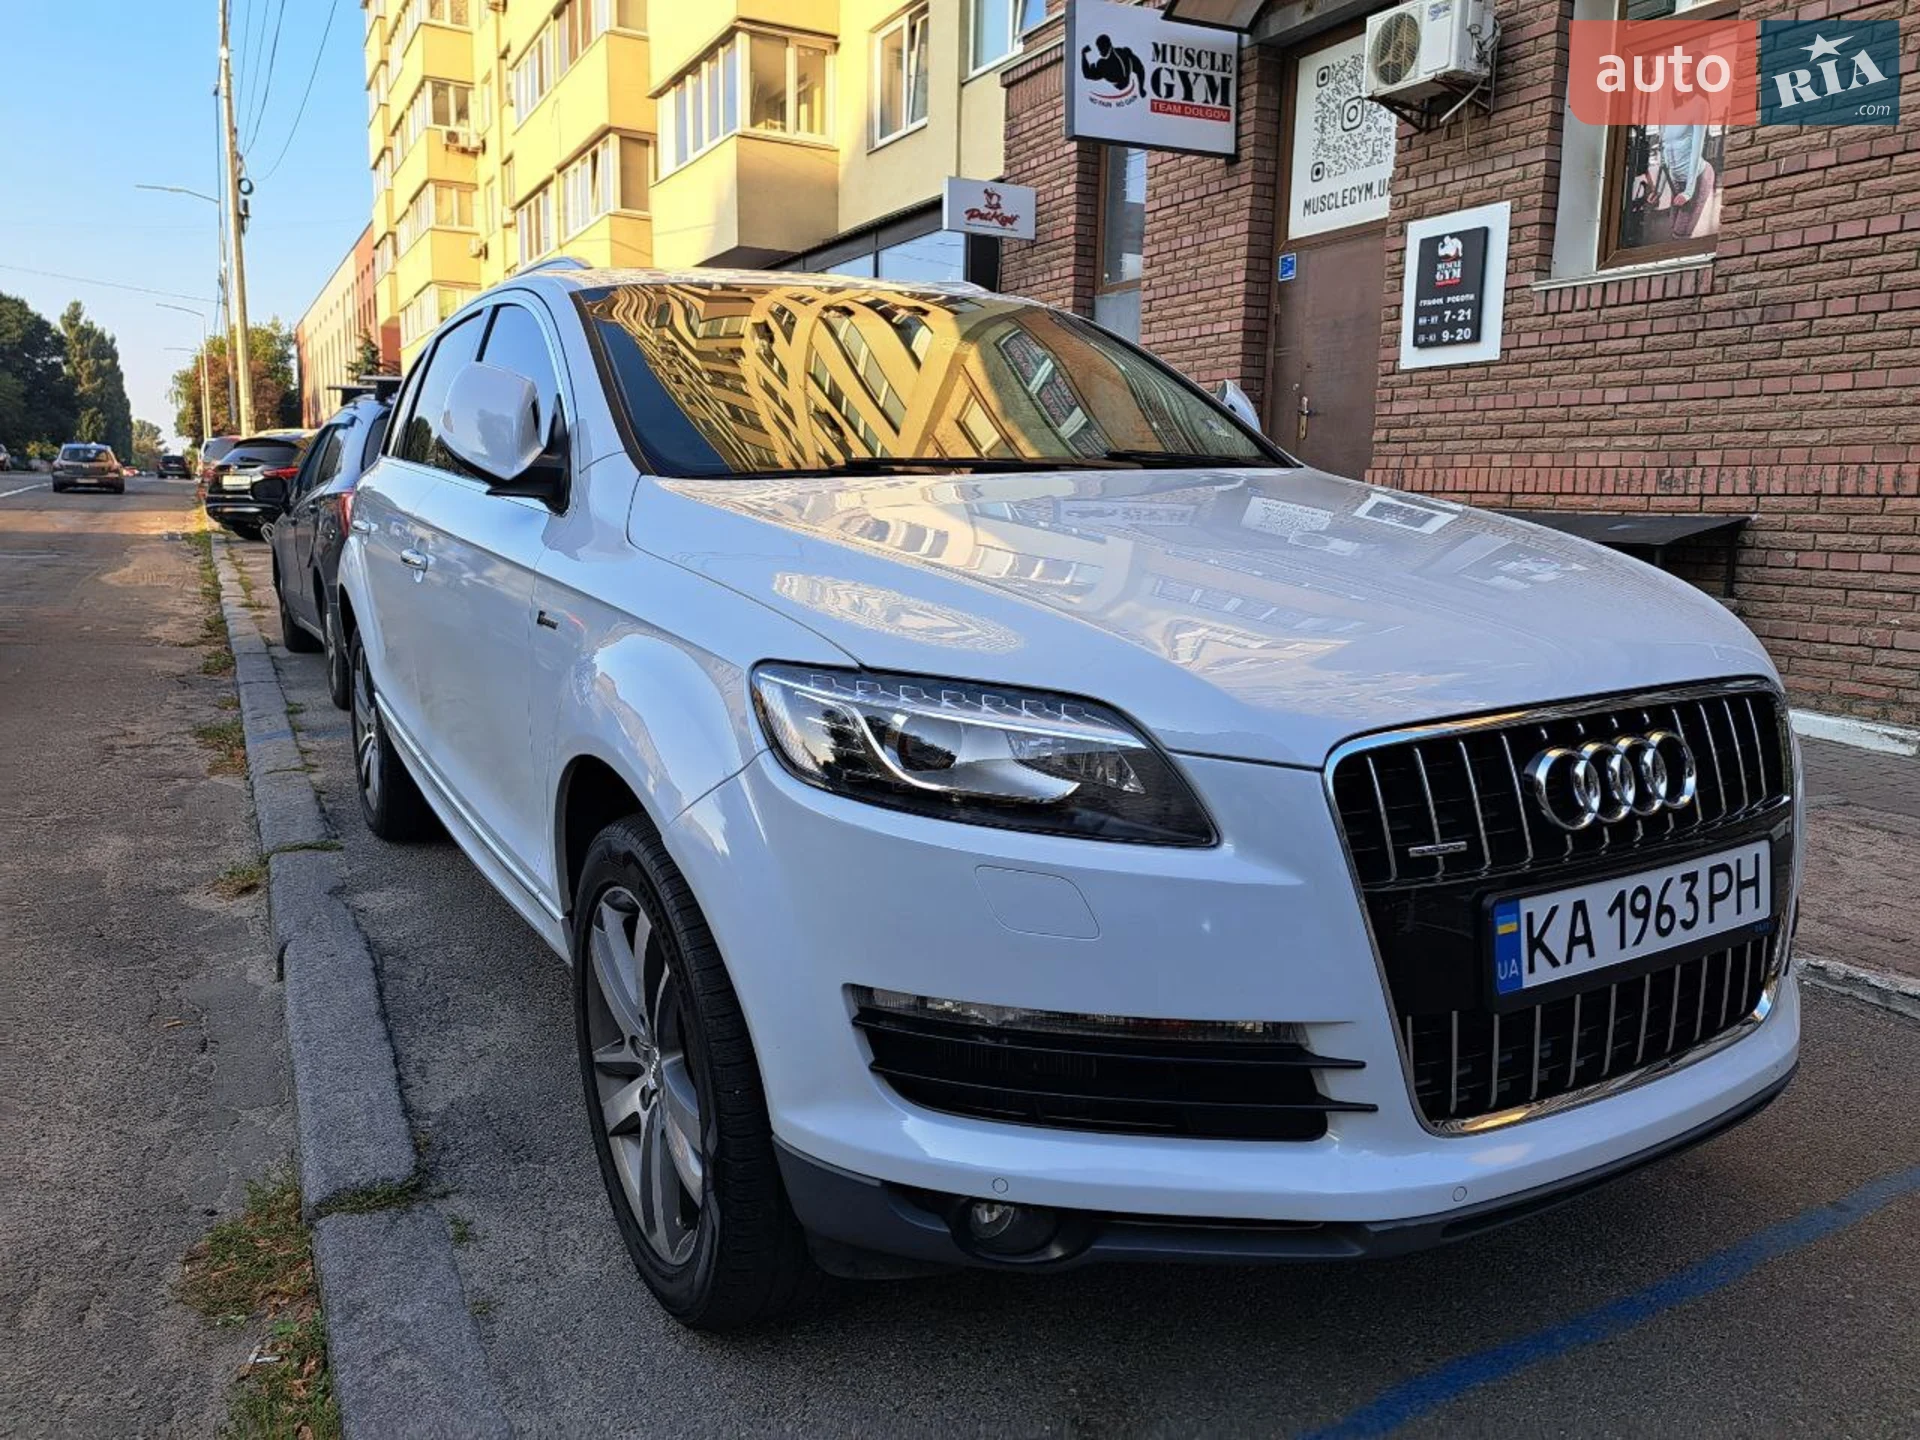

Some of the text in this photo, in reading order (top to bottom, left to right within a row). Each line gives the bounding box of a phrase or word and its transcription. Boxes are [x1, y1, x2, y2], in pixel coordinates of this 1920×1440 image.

[1152, 41, 1233, 74] MUSCLE
[1151, 67, 1232, 107] GYM
[1153, 101, 1228, 119] TEAM DOLGOV
[1435, 268, 1461, 281] GYM
[1444, 308, 1471, 323] 7-21
[1442, 327, 1471, 342] 9-20
[1526, 853, 1760, 974] KA 1963 PH
[1498, 960, 1519, 980] UA
